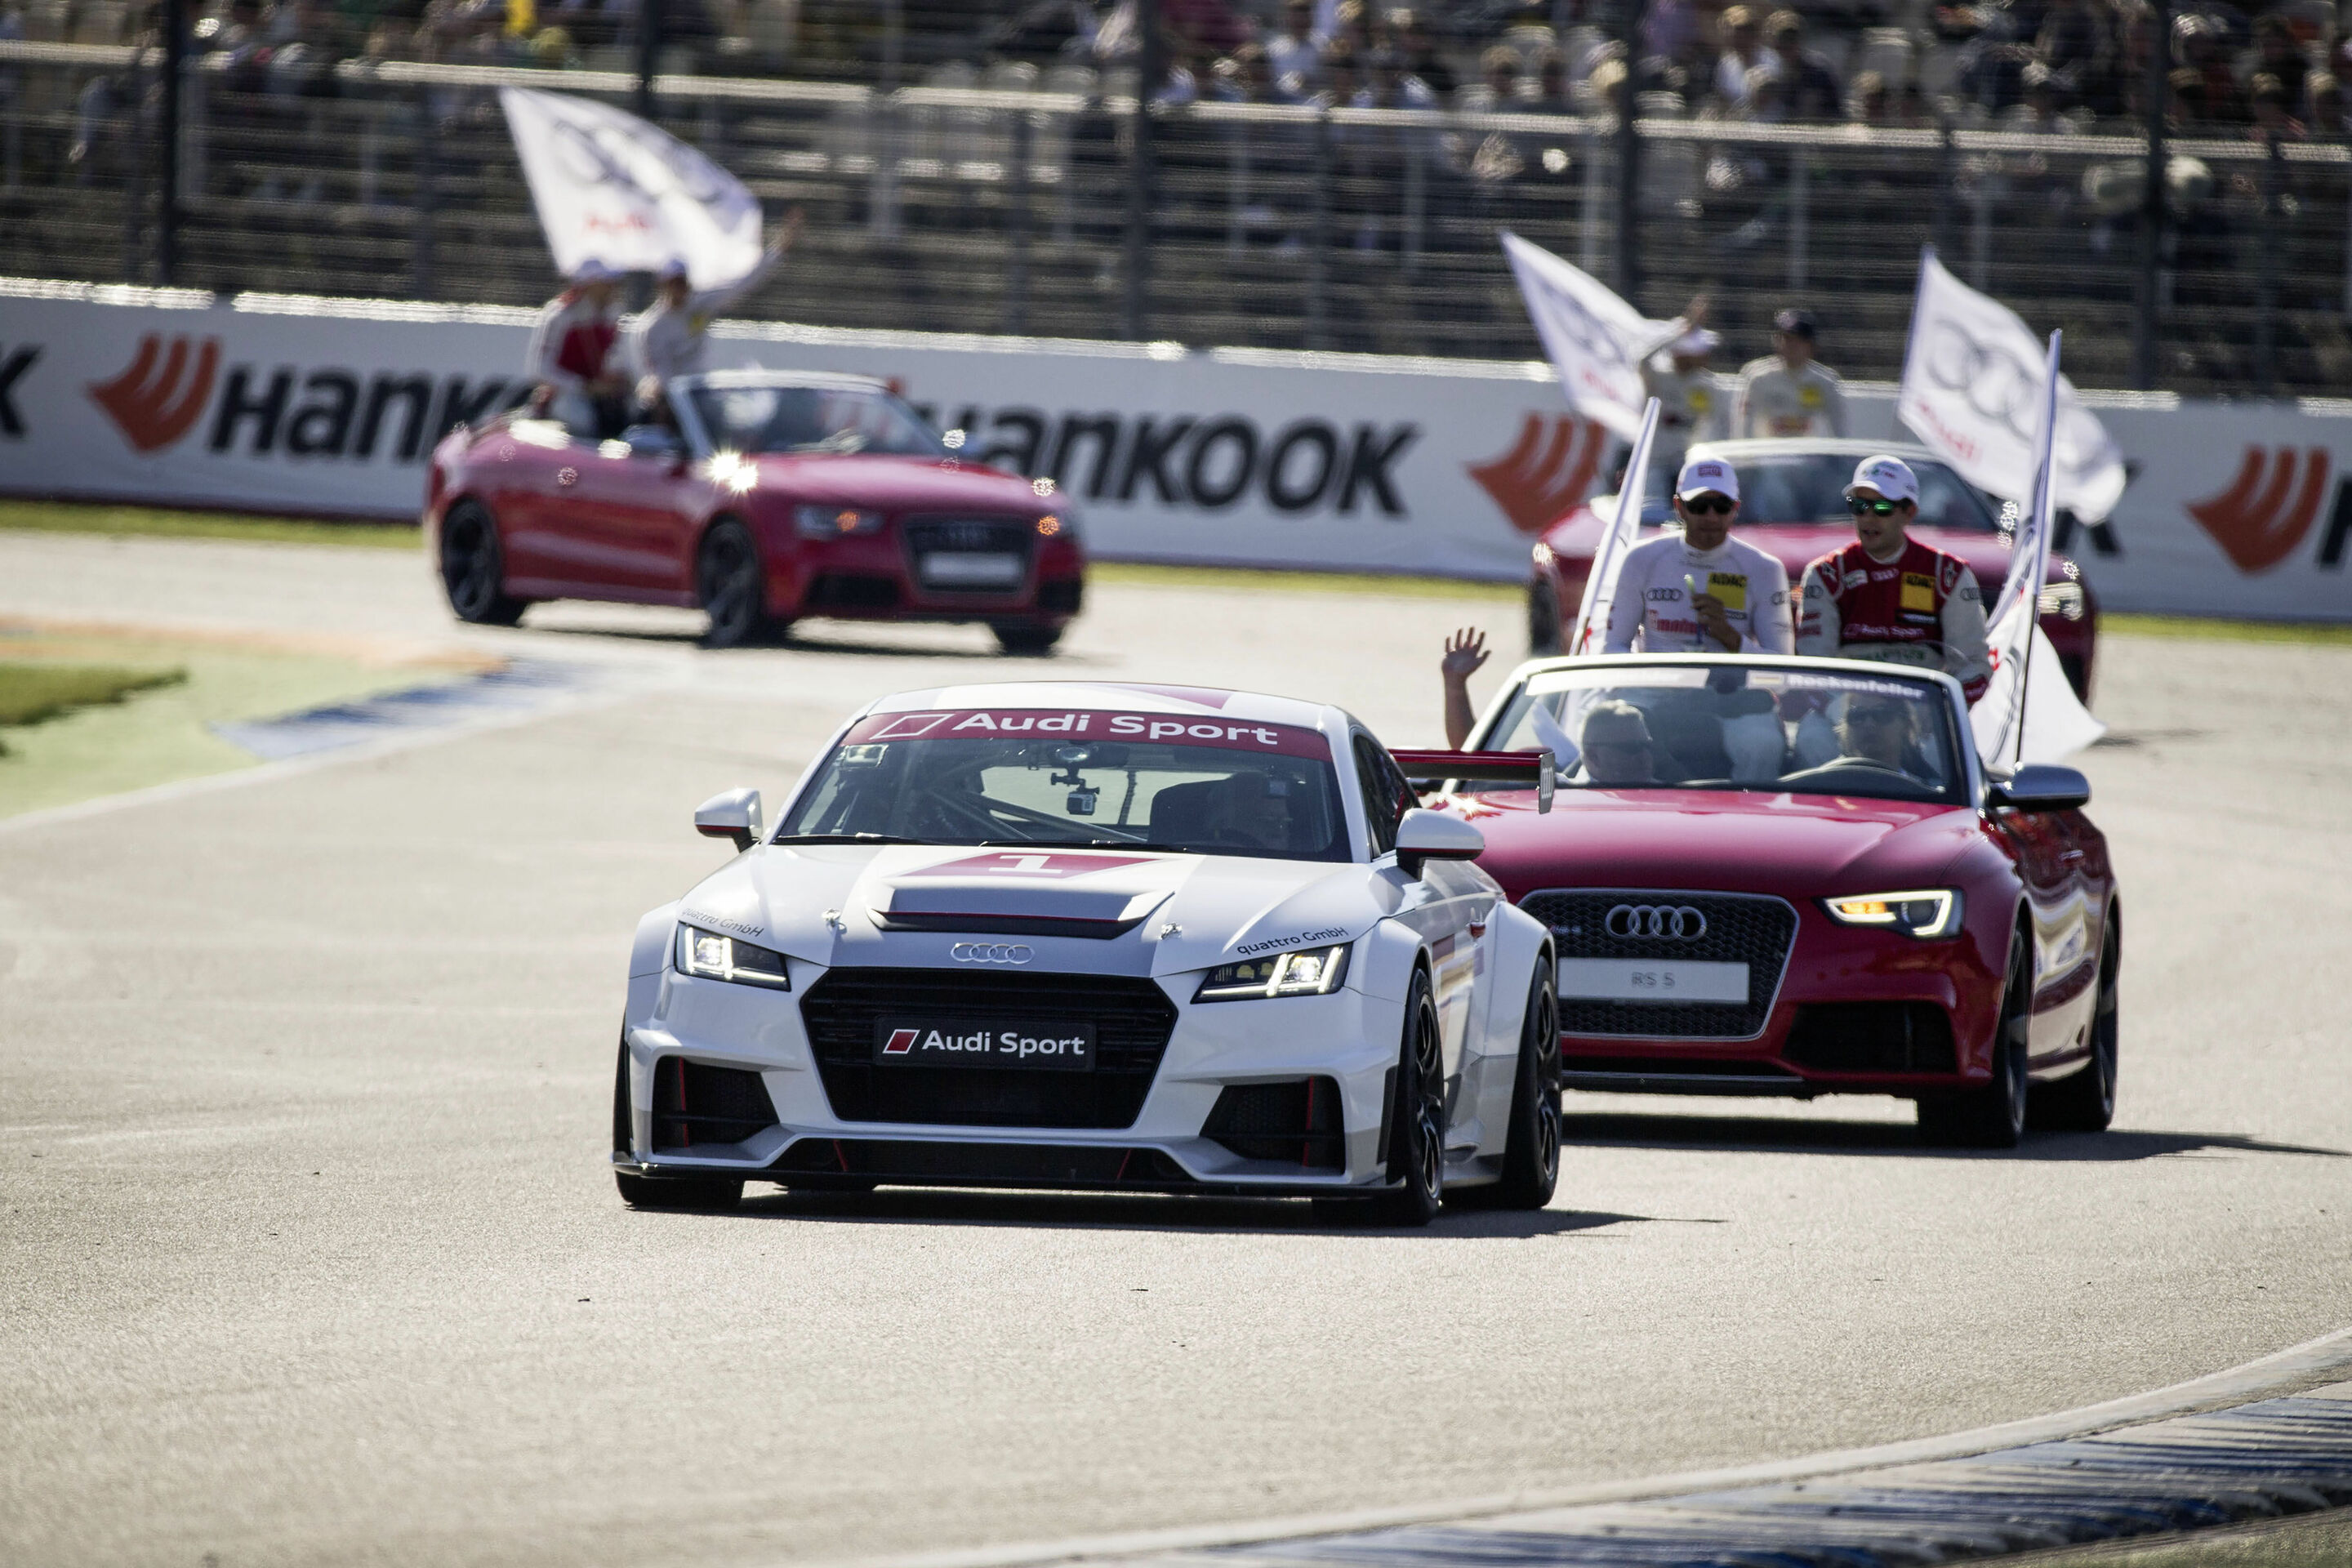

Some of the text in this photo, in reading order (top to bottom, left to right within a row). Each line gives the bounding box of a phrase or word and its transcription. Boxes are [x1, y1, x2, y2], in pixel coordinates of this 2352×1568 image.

[951, 713, 1278, 745] Audi Sport
[989, 855, 1062, 874] 1
[682, 907, 764, 938] quattro GmbH
[1237, 926, 1349, 955] quattro GmbH
[1633, 972, 1676, 987] RS 5
[921, 1030, 1085, 1058] Audi Sport
